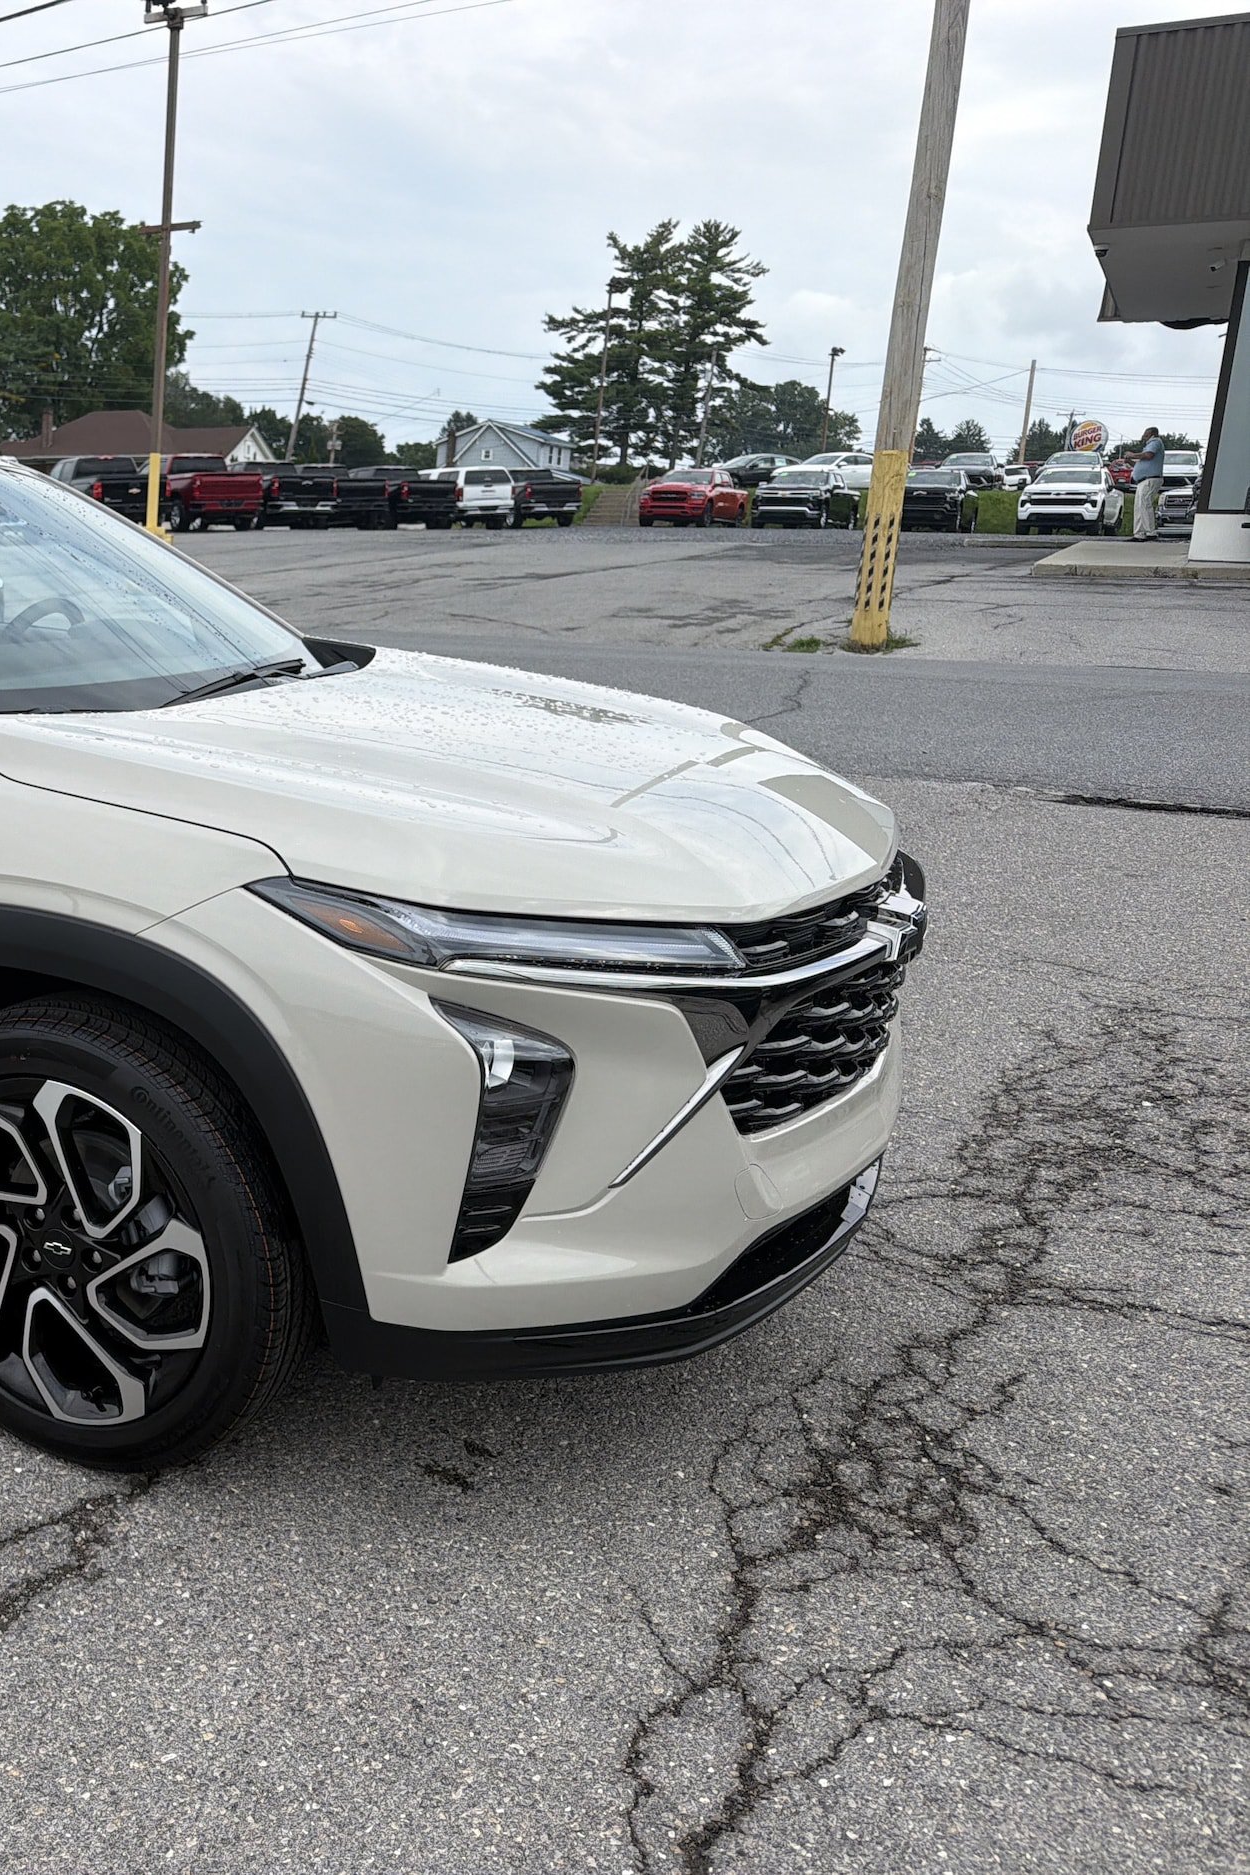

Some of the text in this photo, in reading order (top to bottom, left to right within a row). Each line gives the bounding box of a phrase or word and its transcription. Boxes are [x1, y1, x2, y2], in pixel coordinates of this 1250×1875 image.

[1074, 426, 1102, 440] BURGER
[1074, 433, 1102, 449] KING
[131, 1086, 216, 1187] Continental
